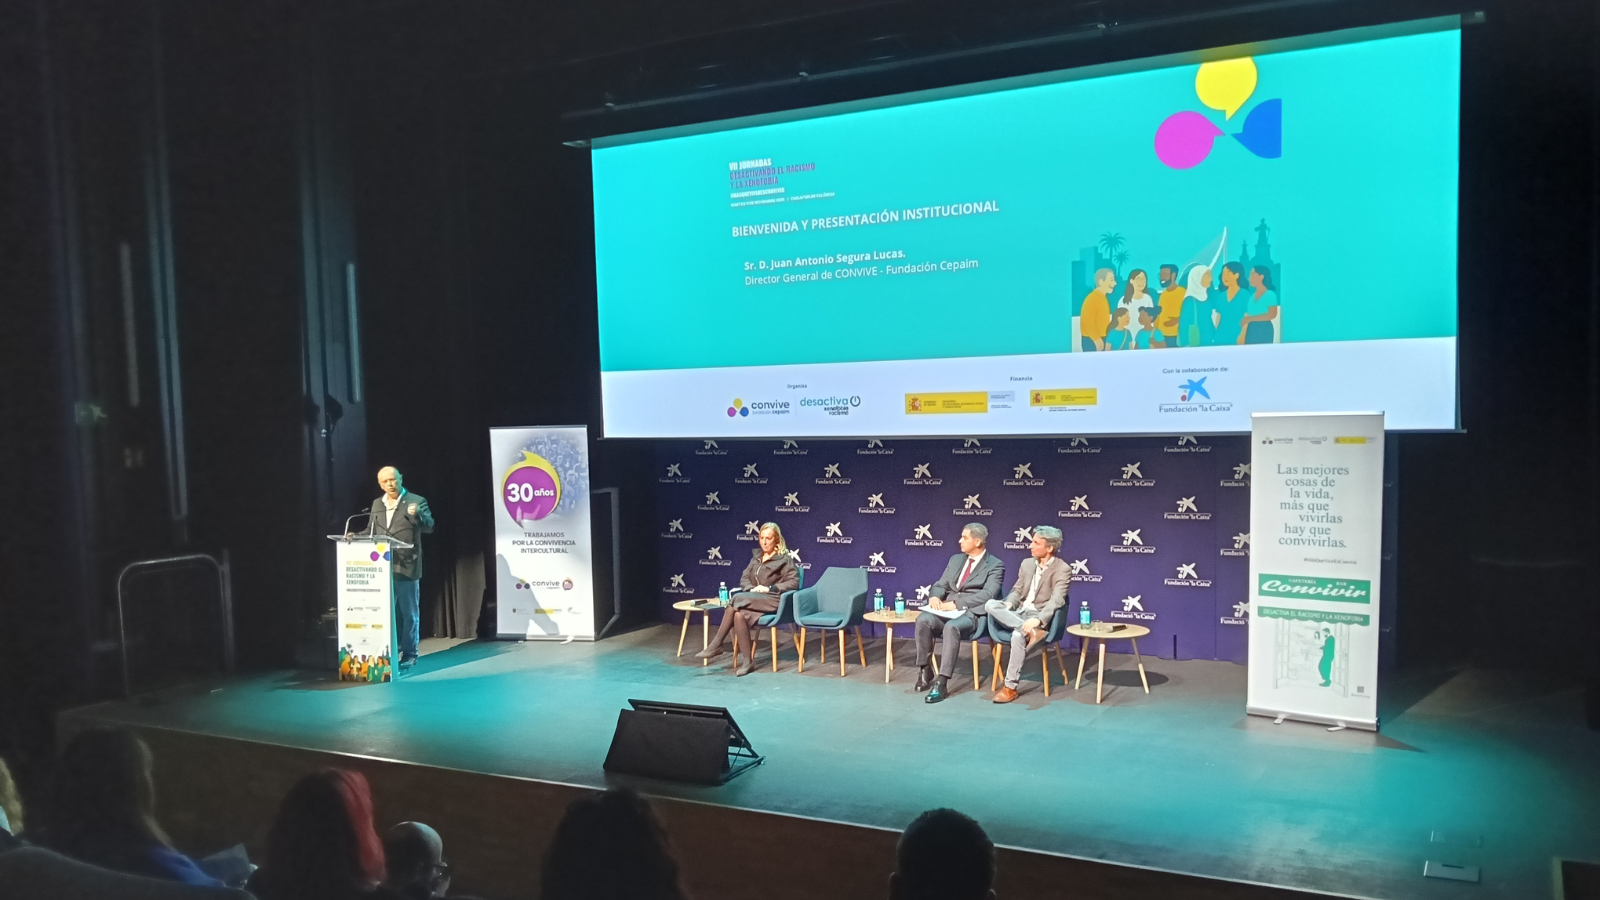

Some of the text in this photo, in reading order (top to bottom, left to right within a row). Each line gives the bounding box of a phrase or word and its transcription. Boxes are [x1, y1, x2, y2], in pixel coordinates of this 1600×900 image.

[729, 158, 772, 171] VII JORNADAS
[730, 167, 775, 180] DESACTIVANDO
[786, 163, 815, 173] RACISMO
[745, 177, 779, 187] XENOFOBIA
[732, 200, 999, 237] BIENVENIDA Y PRESENTACIÓN INSTITUCIONAL
[744, 250, 906, 270] Sr. D. Juan Antonio Segura Lucas.
[745, 276, 780, 286] Director
[783, 271, 818, 283] General
[821, 270, 832, 279] de
[835, 267, 877, 278] CONVIVE
[886, 261, 937, 274] Fundación
[940, 259, 978, 272] Cepaim
[751, 400, 790, 410] convive
[800, 396, 848, 406] desactiva
[1277, 464, 1349, 477] Las mejores
[1285, 476, 1335, 487] cosas de
[507, 483, 554, 502] 30 años
[1290, 488, 1334, 500] la vida,
[1280, 500, 1329, 513] más que
[1299, 512, 1343, 523] vivirlas
[1284, 523, 1331, 537] hay que
[1279, 536, 1346, 548] convivirlas.
[1261, 580, 1366, 598] Convivir
